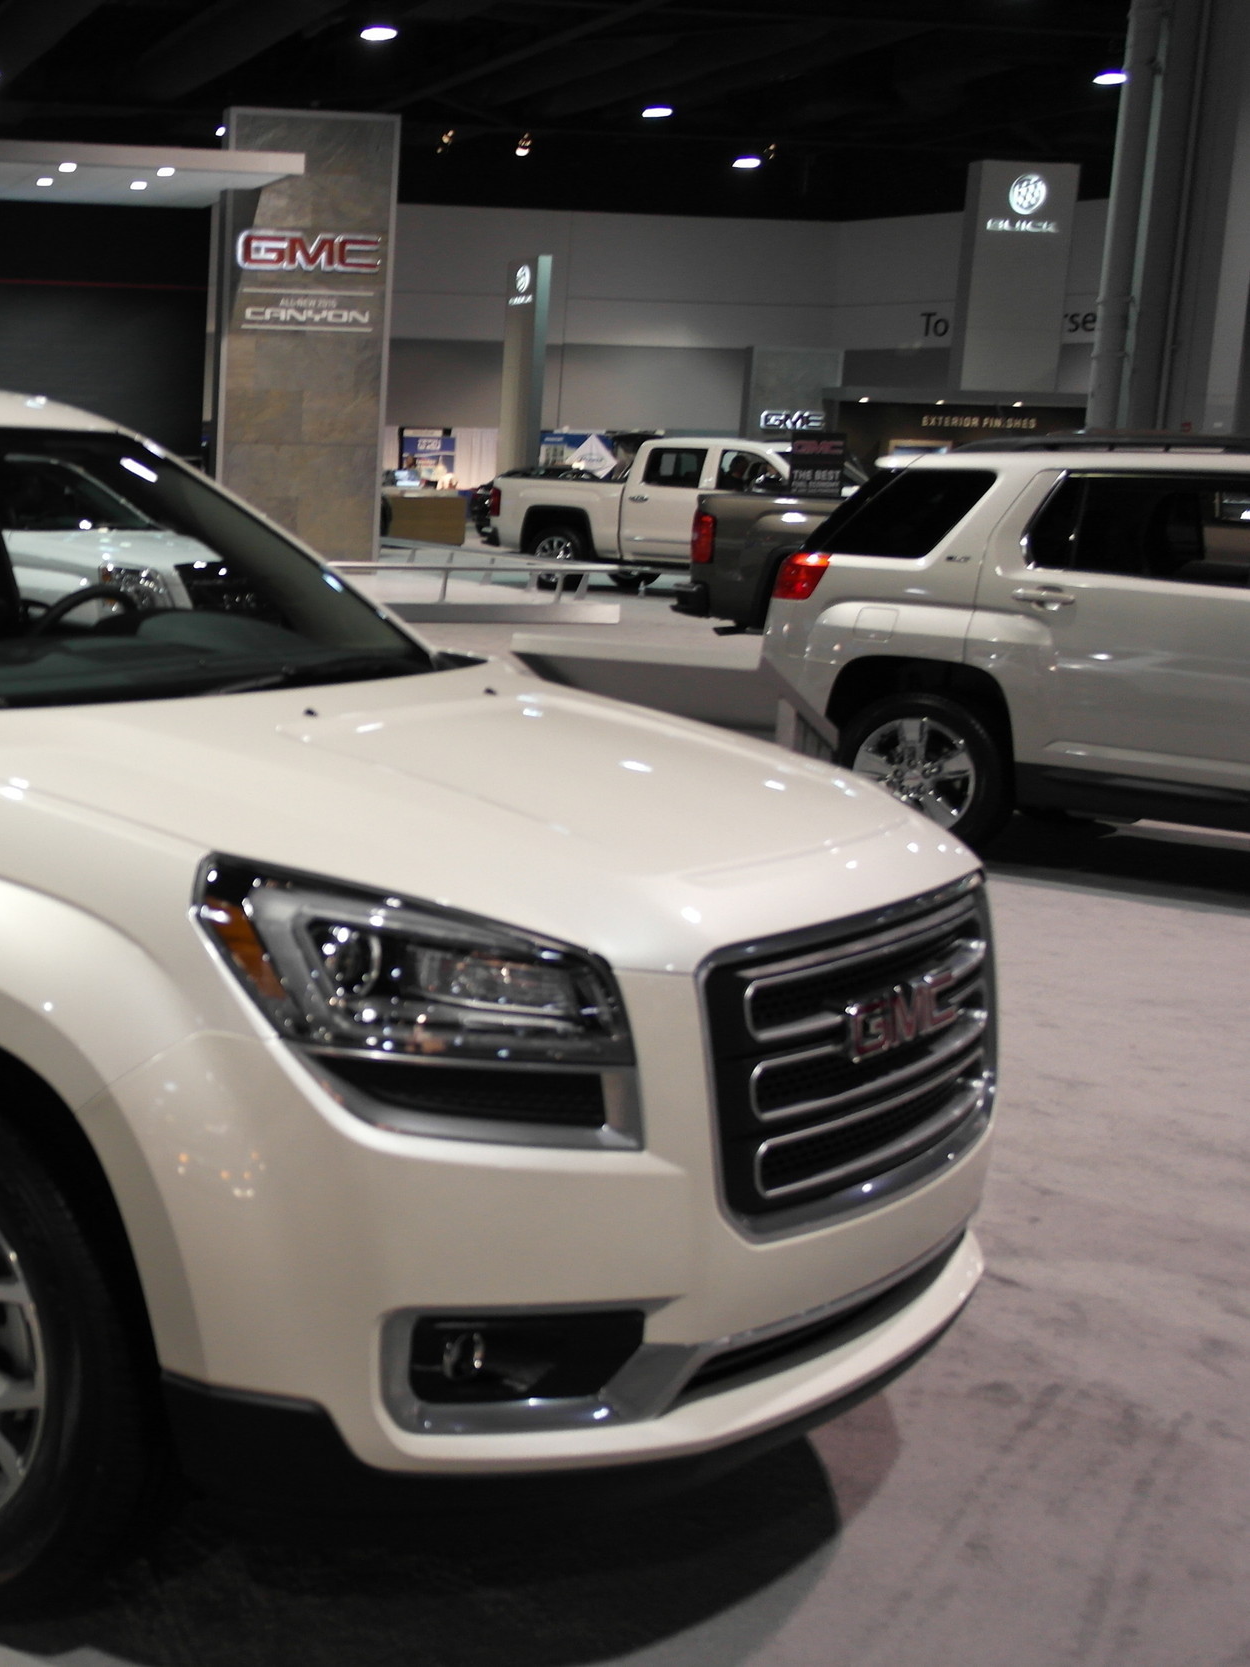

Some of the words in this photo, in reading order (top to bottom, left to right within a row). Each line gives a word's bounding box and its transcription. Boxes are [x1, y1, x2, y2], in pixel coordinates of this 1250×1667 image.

[236, 229, 381, 273] GMC
[245, 306, 370, 324] CANYON
[759, 409, 826, 431] GMC
[921, 415, 979, 427] EXTERIOR
[847, 971, 961, 1062] GMC
